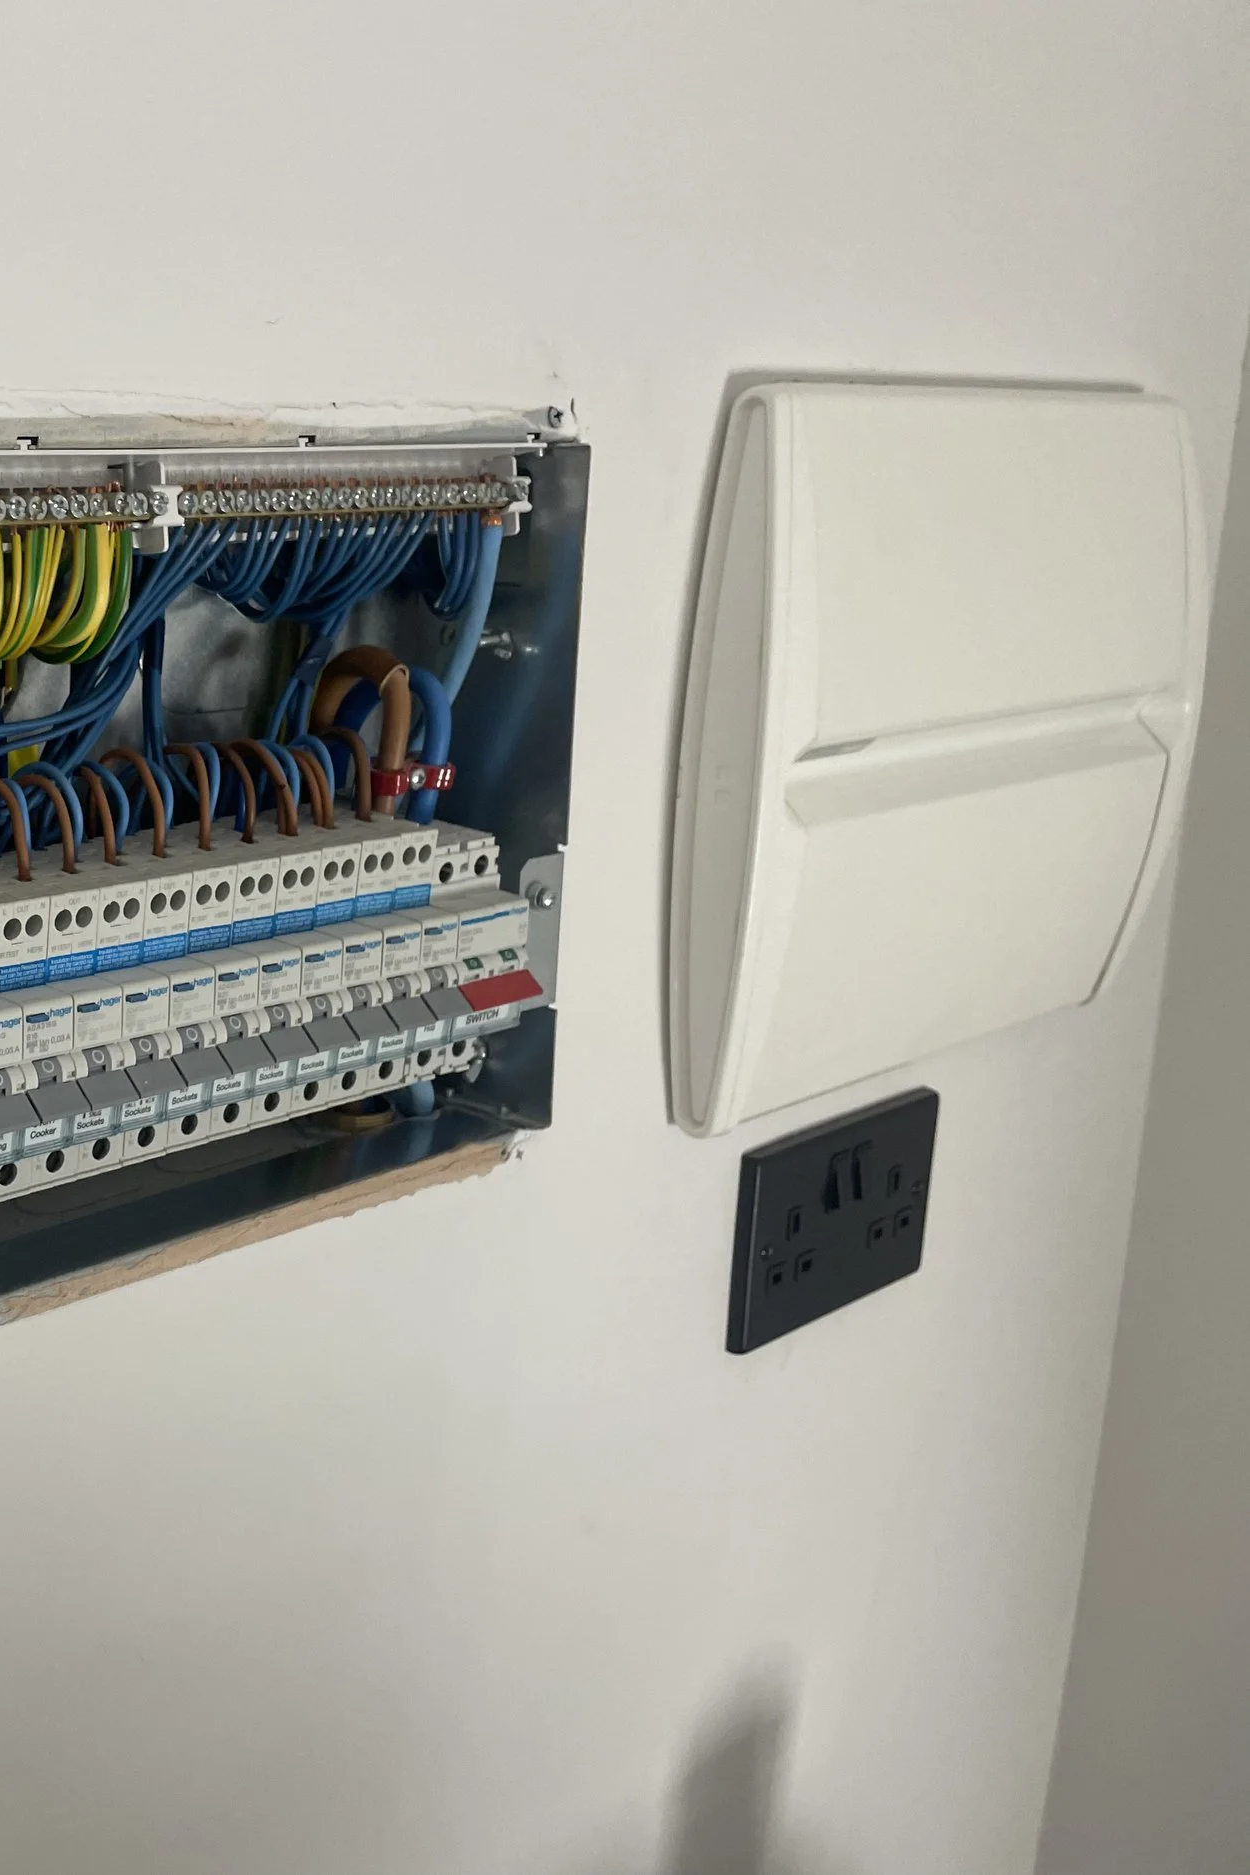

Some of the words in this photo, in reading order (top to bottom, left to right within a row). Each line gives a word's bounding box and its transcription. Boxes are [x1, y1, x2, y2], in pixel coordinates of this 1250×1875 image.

[147, 985, 169, 998] hager
[99, 995, 122, 1007] hager
[50, 1006, 73, 1019] hager
[465, 1008, 500, 1025] SWITCH
[300, 1059, 325, 1071] Sockets
[258, 1069, 284, 1081] Sockets
[215, 1080, 241, 1092] Sockets
[171, 1092, 198, 1106] Sockets
[124, 1105, 152, 1118] Sockets
[76, 1117, 105, 1130] Sockets
[30, 1125, 57, 1140] Cooker
